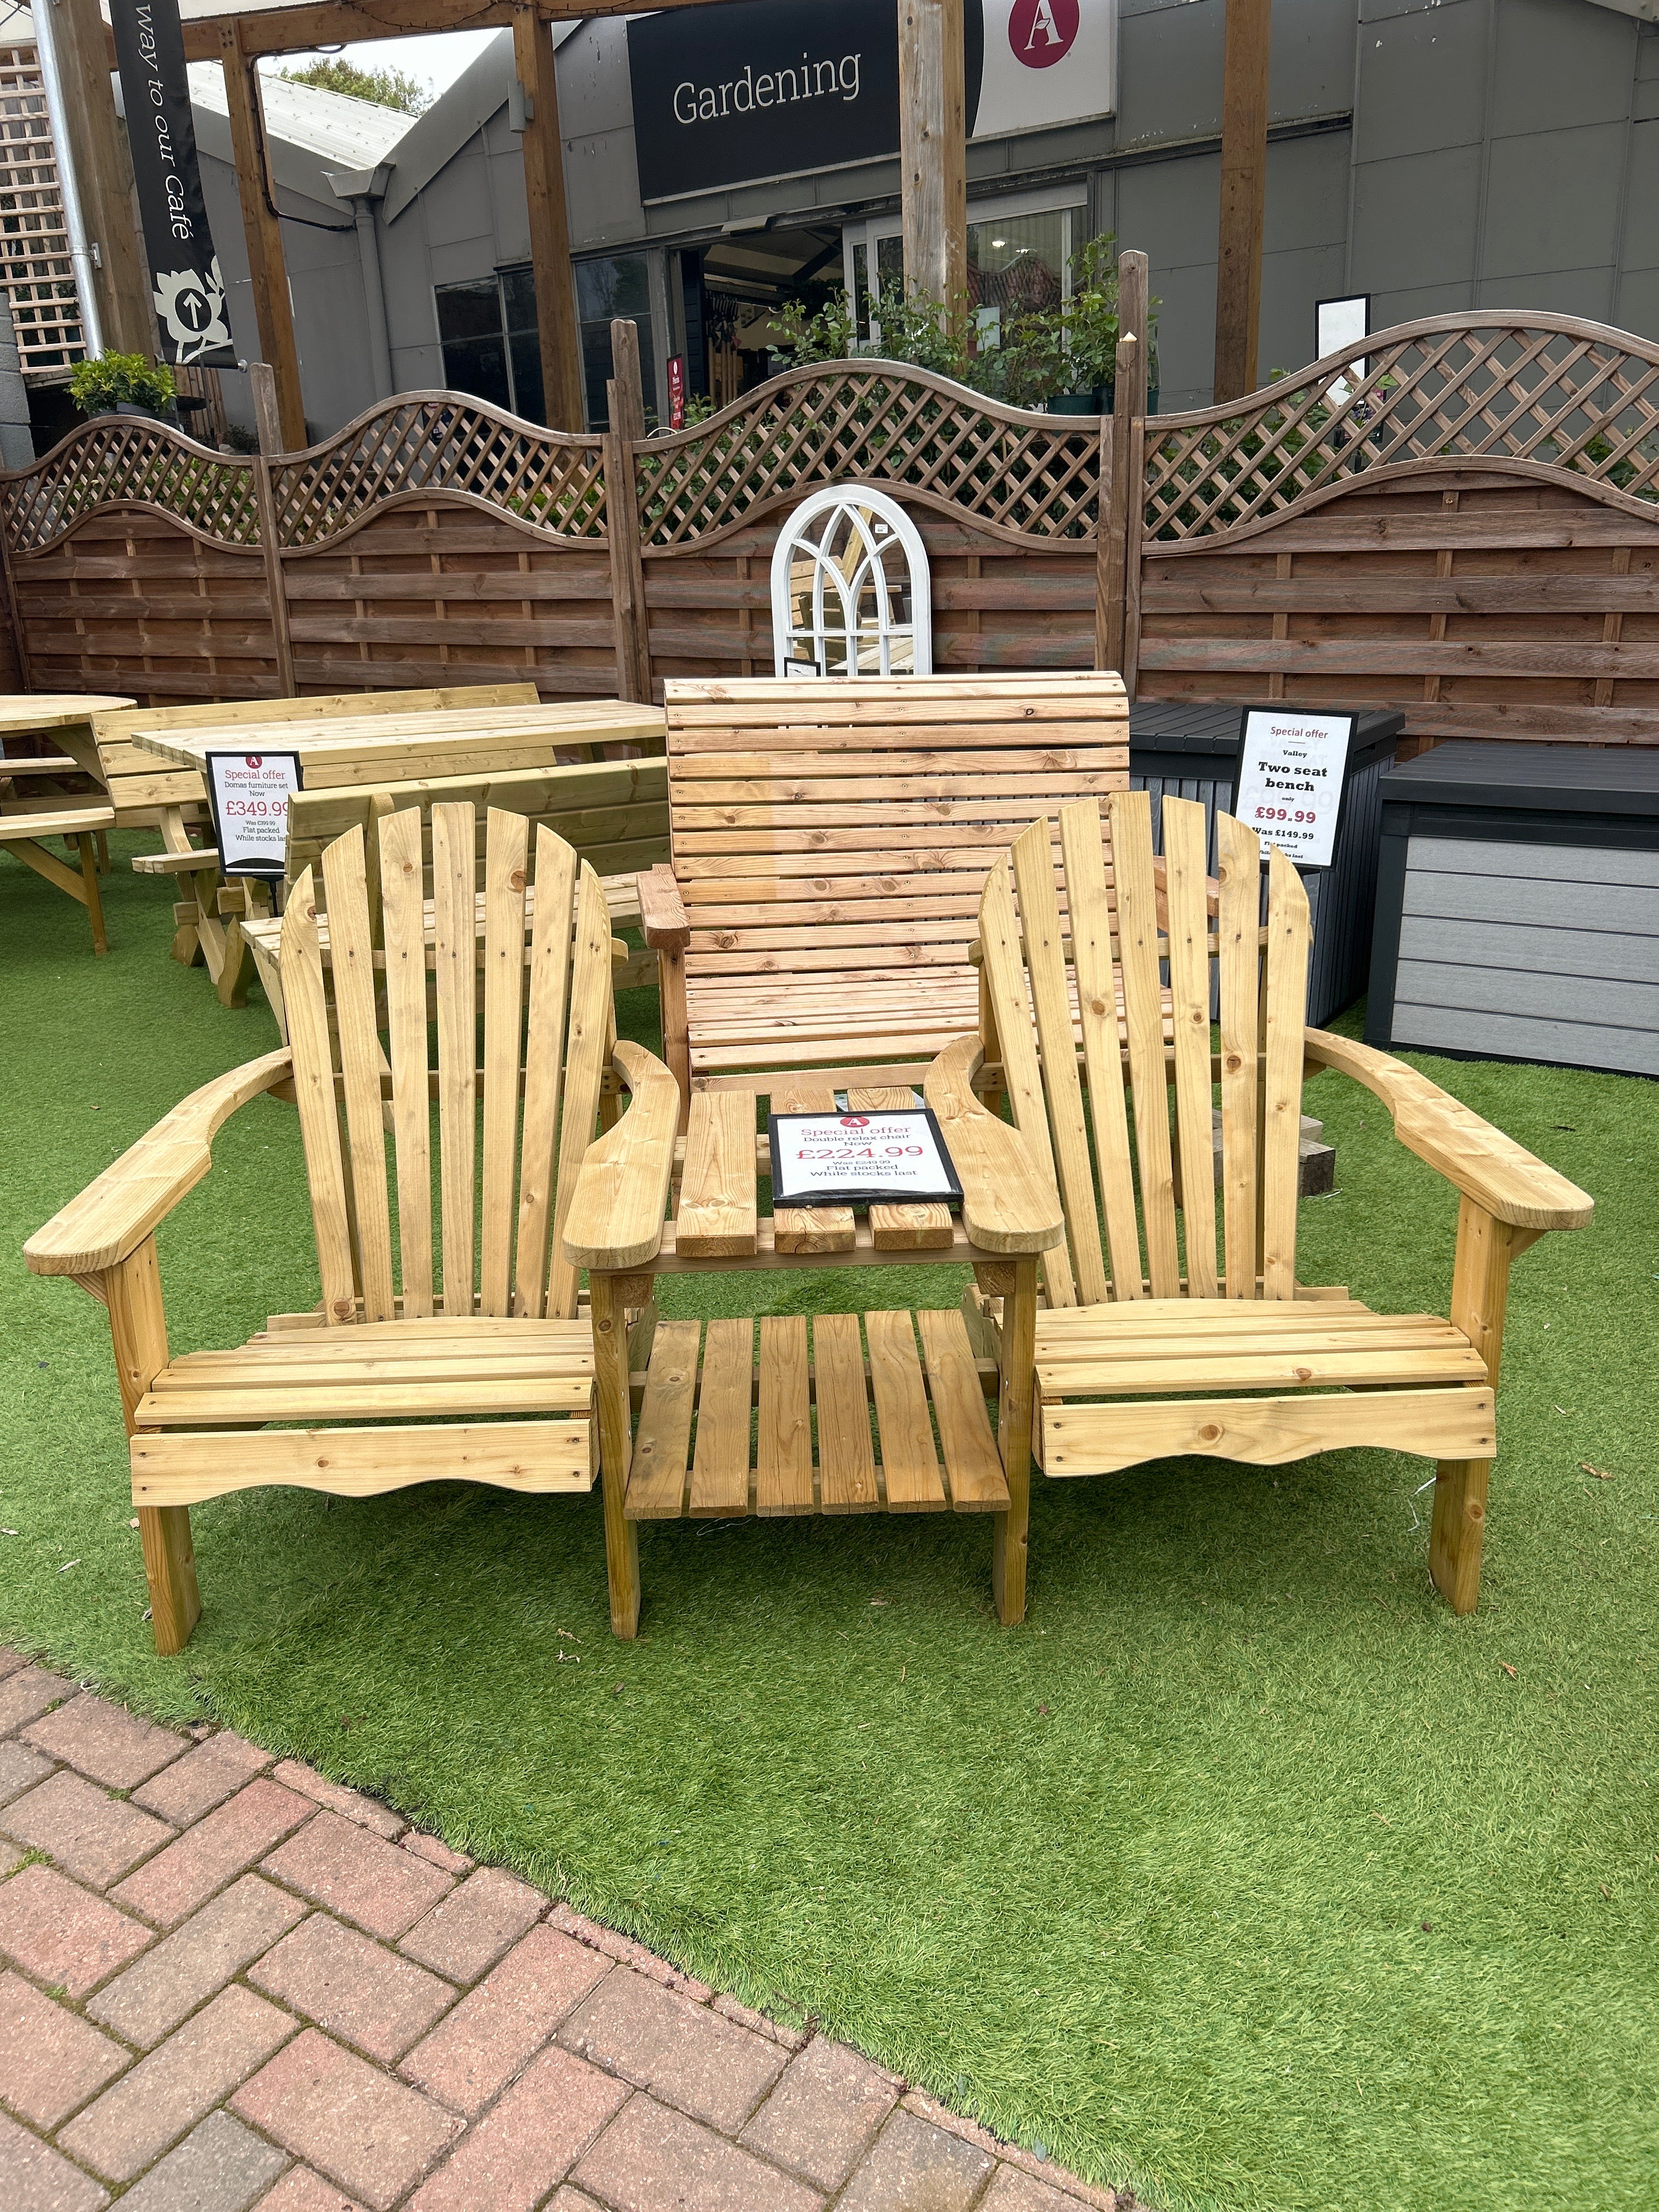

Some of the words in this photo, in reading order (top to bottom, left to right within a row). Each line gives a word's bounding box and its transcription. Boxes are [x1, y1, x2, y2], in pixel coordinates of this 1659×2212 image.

[136, 4, 159, 72] way
[149, 80, 163, 106] to
[673, 52, 861, 123] Gardening
[155, 115, 175, 167] our
[165, 174, 194, 239] Café
[1270, 726, 1304, 736] Special
[1306, 729, 1329, 738] offer
[1283, 750, 1307, 758] Valley
[225, 770, 260, 781] Special
[262, 770, 285, 780] offer
[1258, 761, 1290, 774] Two
[1294, 767, 1328, 777] seat
[1265, 777, 1314, 792] bench
[1255, 806, 1316, 823] £99.99
[1251, 827, 1273, 836] Was
[1274, 830, 1314, 839] £149.99
[801, 1128, 865, 1137] Special
[795, 1146, 923, 1159] £224.99
